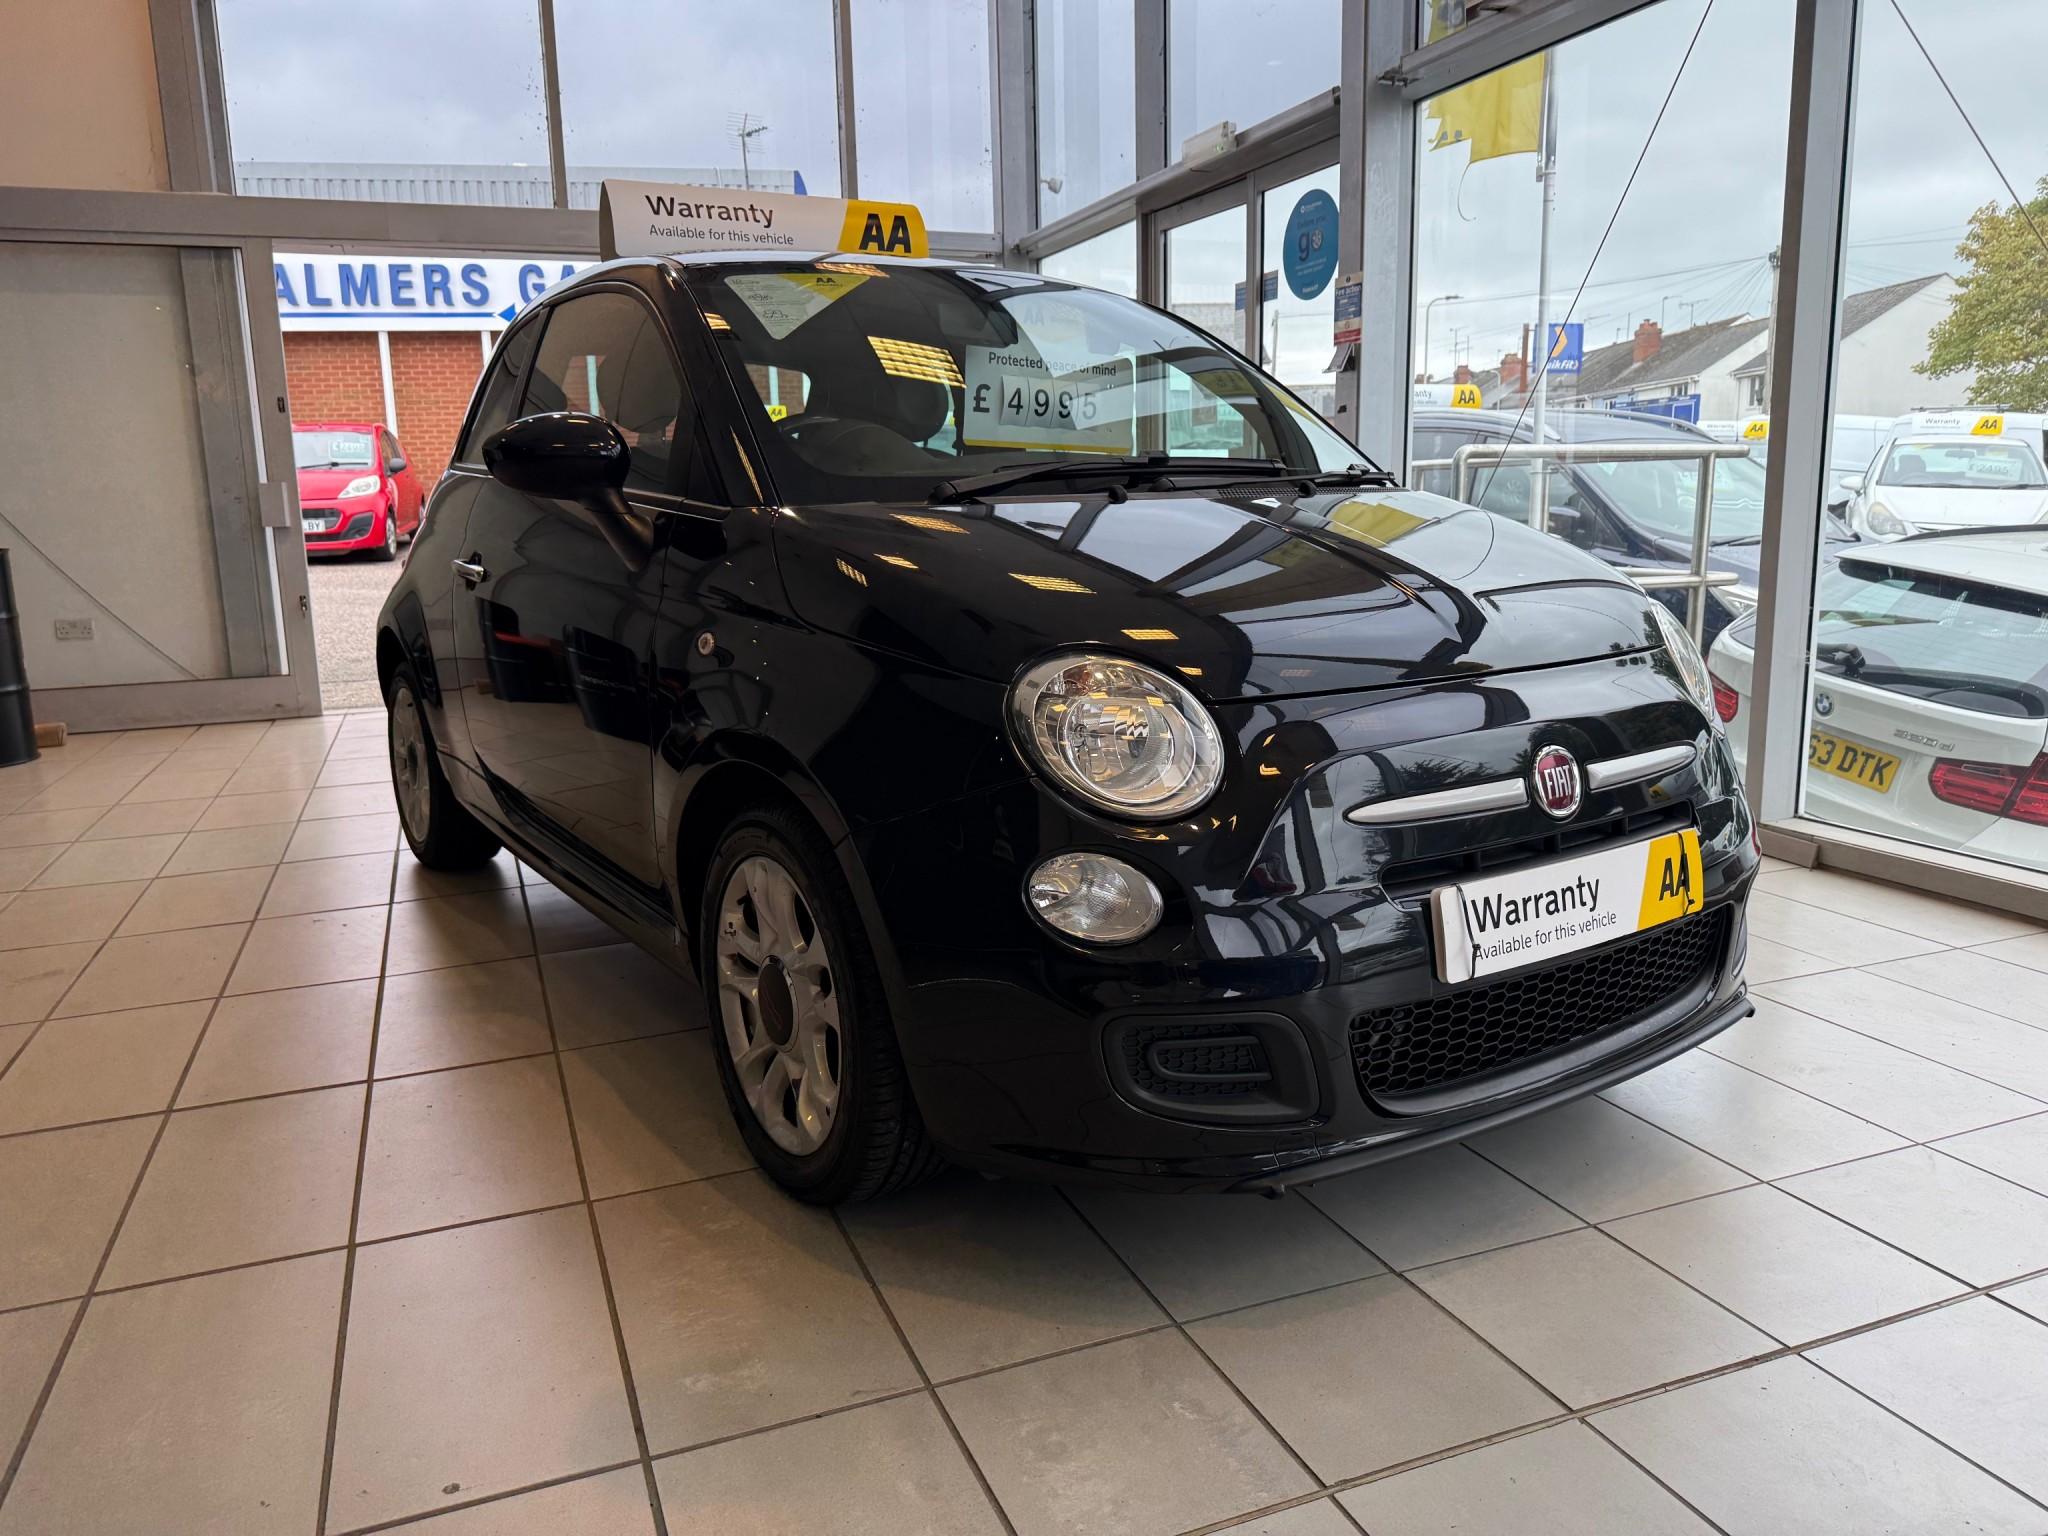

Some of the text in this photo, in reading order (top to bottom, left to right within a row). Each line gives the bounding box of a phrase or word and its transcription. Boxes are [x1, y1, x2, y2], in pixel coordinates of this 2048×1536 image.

[645, 194, 774, 228] Warranty
[649, 224, 794, 245] Available for this vehicle
[859, 213, 912, 253] AA
[988, 351, 1043, 369] Protected
[1092, 363, 1117, 377] mind
[770, 407, 784, 417] AA
[1007, 387, 1097, 420] 4995
[1458, 389, 1476, 405] AA
[1750, 423, 1765, 433] AA
[1925, 417, 1961, 425] Warranty
[1980, 419, 1998, 430] AA
[1543, 763, 1573, 800] FIAT
[1836, 745, 1893, 787] DTK
[1659, 855, 1690, 901] AA
[1470, 874, 1600, 933] Warranty
[1474, 911, 1617, 961] Available for this vehicle
